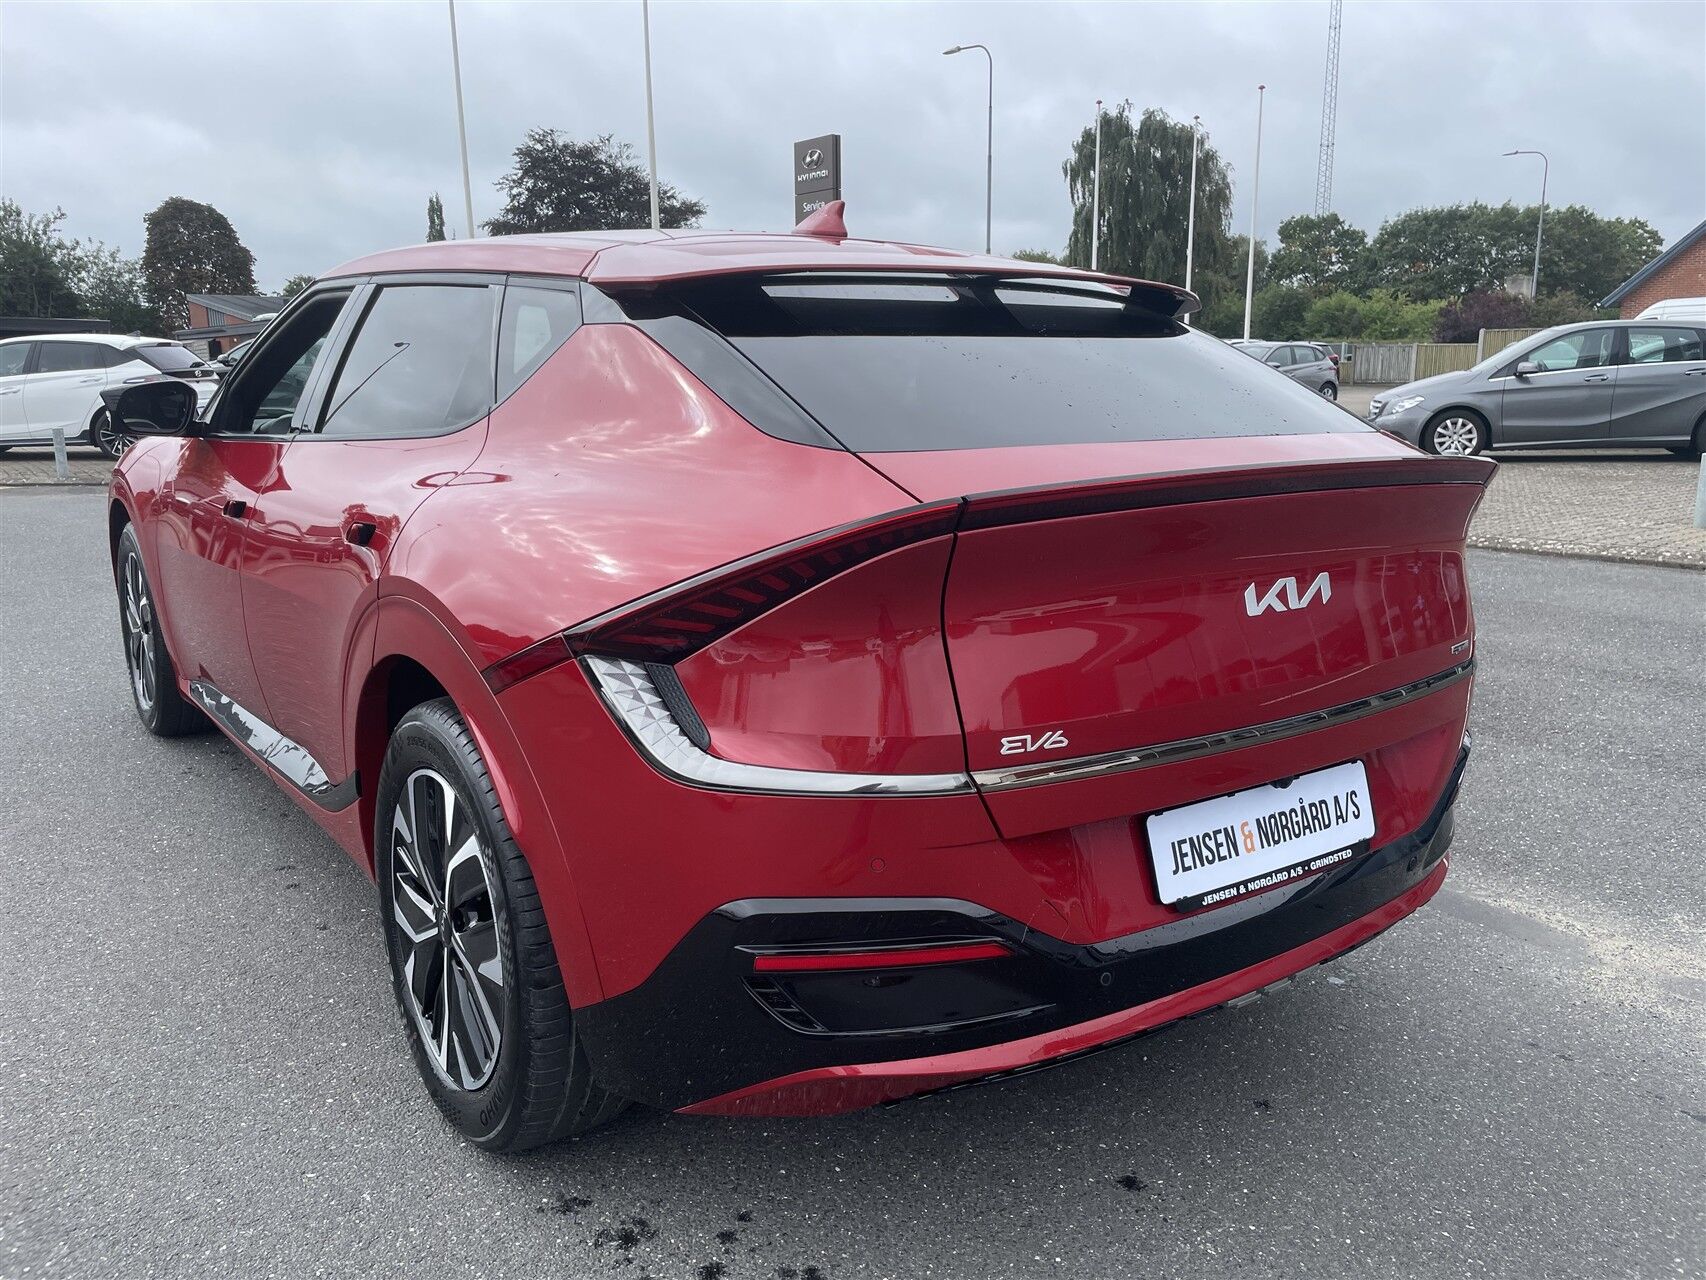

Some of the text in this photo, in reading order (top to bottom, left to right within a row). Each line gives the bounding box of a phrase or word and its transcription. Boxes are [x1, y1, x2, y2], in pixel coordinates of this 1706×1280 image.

[797, 169, 829, 182] HYUNDAI
[1244, 571, 1332, 616] KIA
[1000, 730, 1069, 755] EV6
[1170, 789, 1361, 876] JENSEN & NØRGÅRD A/S
[1202, 849, 1353, 906] JENSEN & NØRGÅRD A/S GRINDSTED
